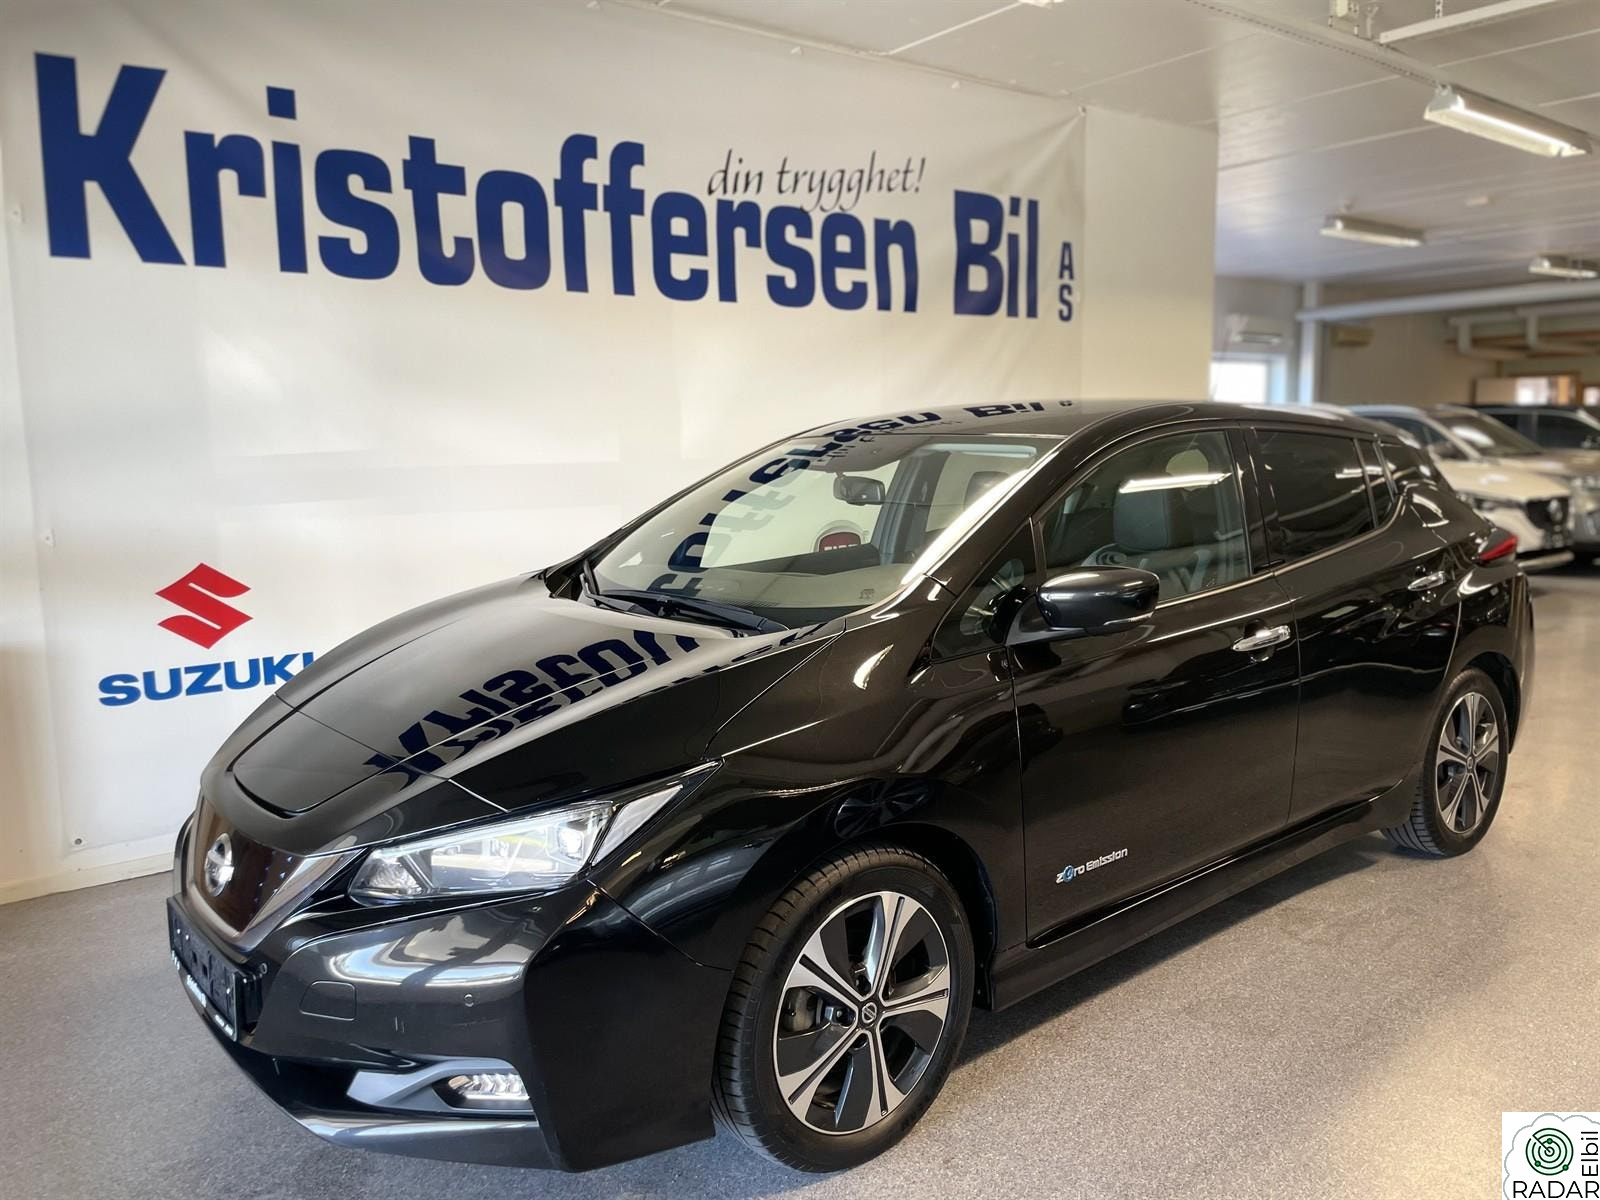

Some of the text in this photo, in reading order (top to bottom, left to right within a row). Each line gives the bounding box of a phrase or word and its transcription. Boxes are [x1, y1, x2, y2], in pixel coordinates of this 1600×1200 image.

[34, 51, 918, 314] Kristoffersen
[954, 189, 1039, 319] Bil
[707, 148, 926, 213] din trygghet!
[1086, 848, 1128, 872] Emission
